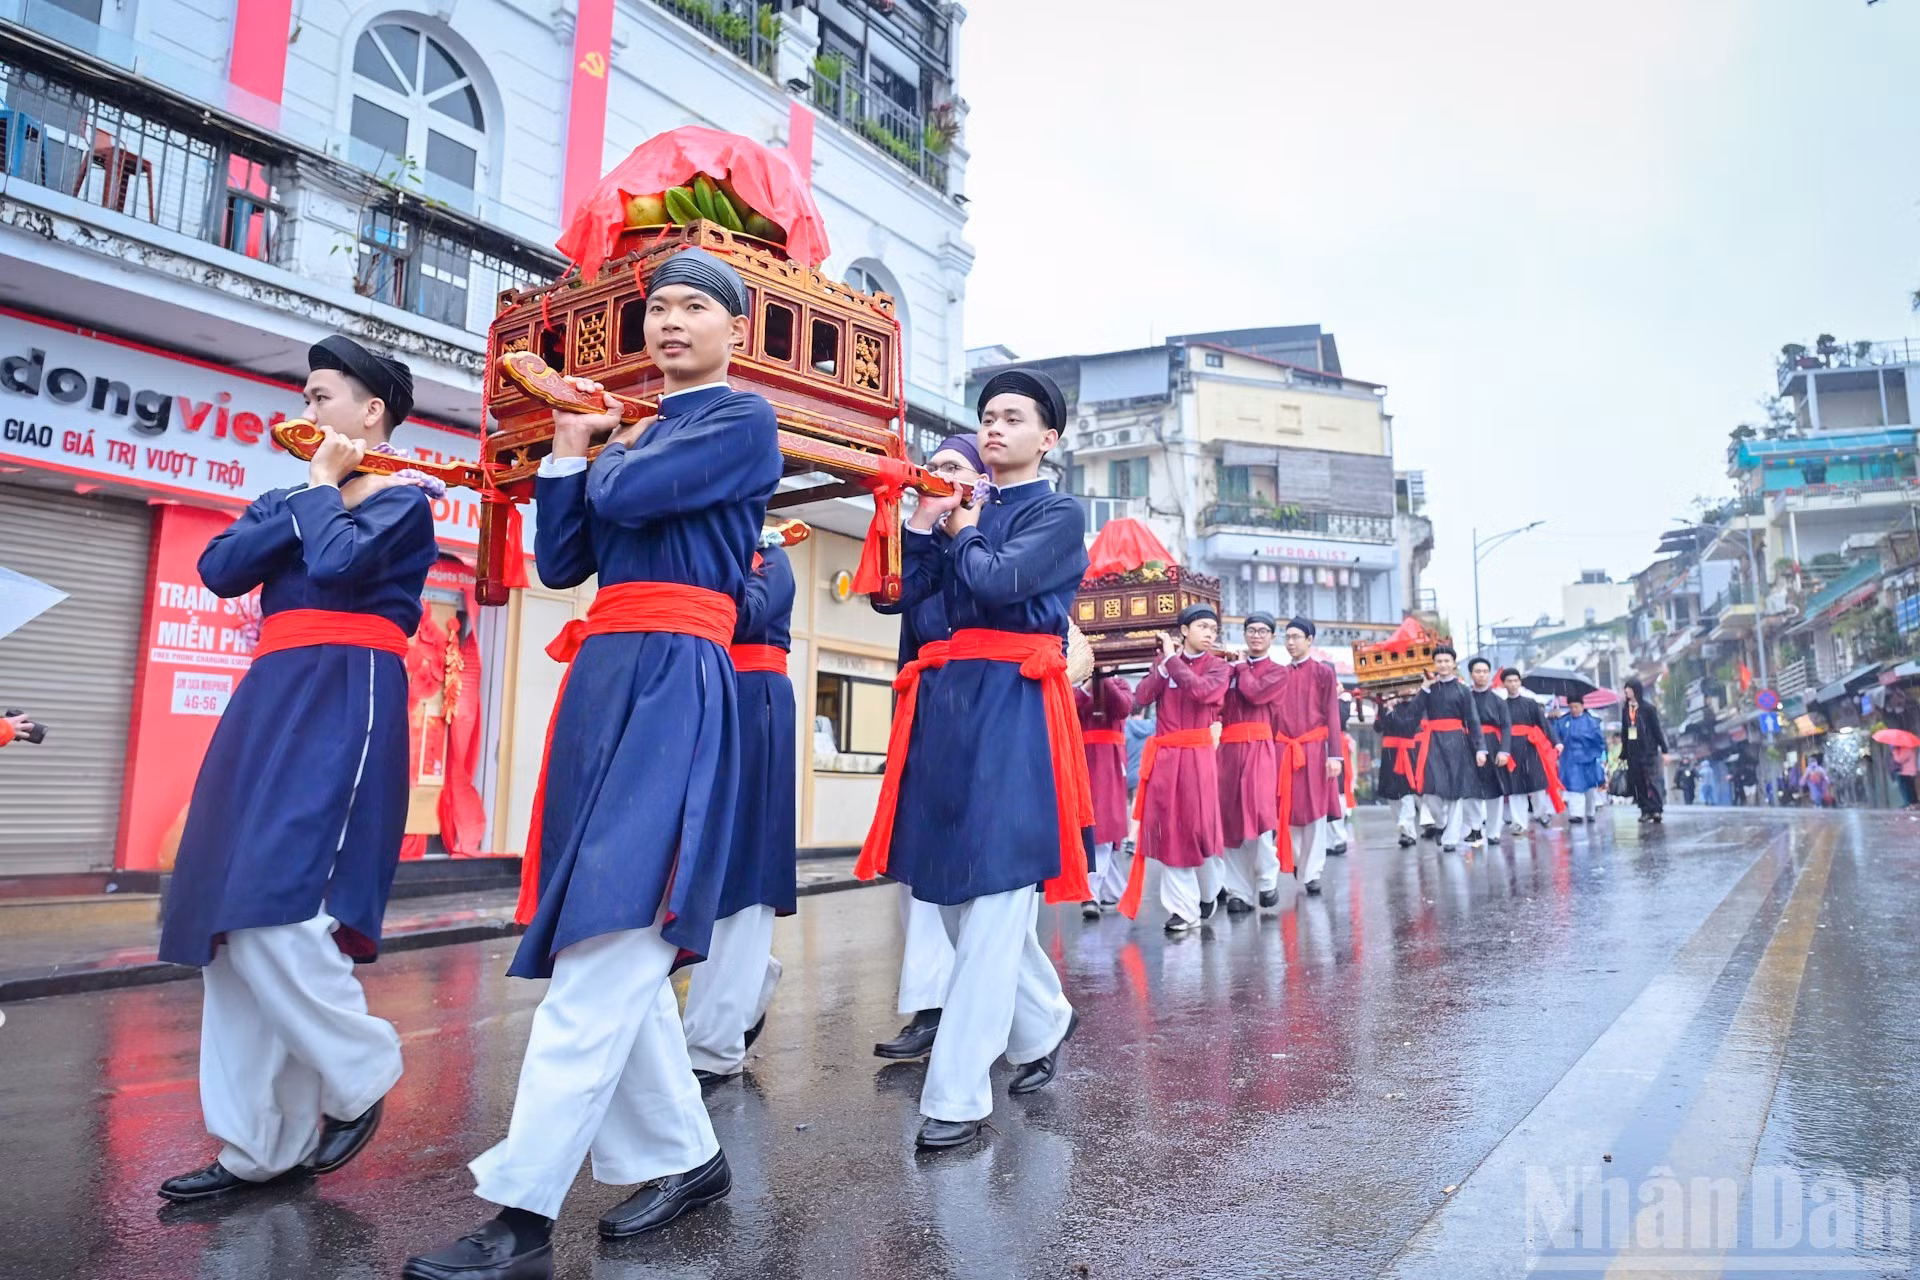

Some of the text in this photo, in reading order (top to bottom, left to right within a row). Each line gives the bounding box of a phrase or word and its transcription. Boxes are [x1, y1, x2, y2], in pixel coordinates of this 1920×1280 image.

[4, 418, 246, 489] GIAO GIÁ TRỊ VƯỢT TRỘI
[1265, 545, 1348, 561] HERBALIST
[158, 581, 219, 615] TRẠM
[157, 615, 254, 655] MIỄN PH
[184, 695, 217, 711] 4G-5G
